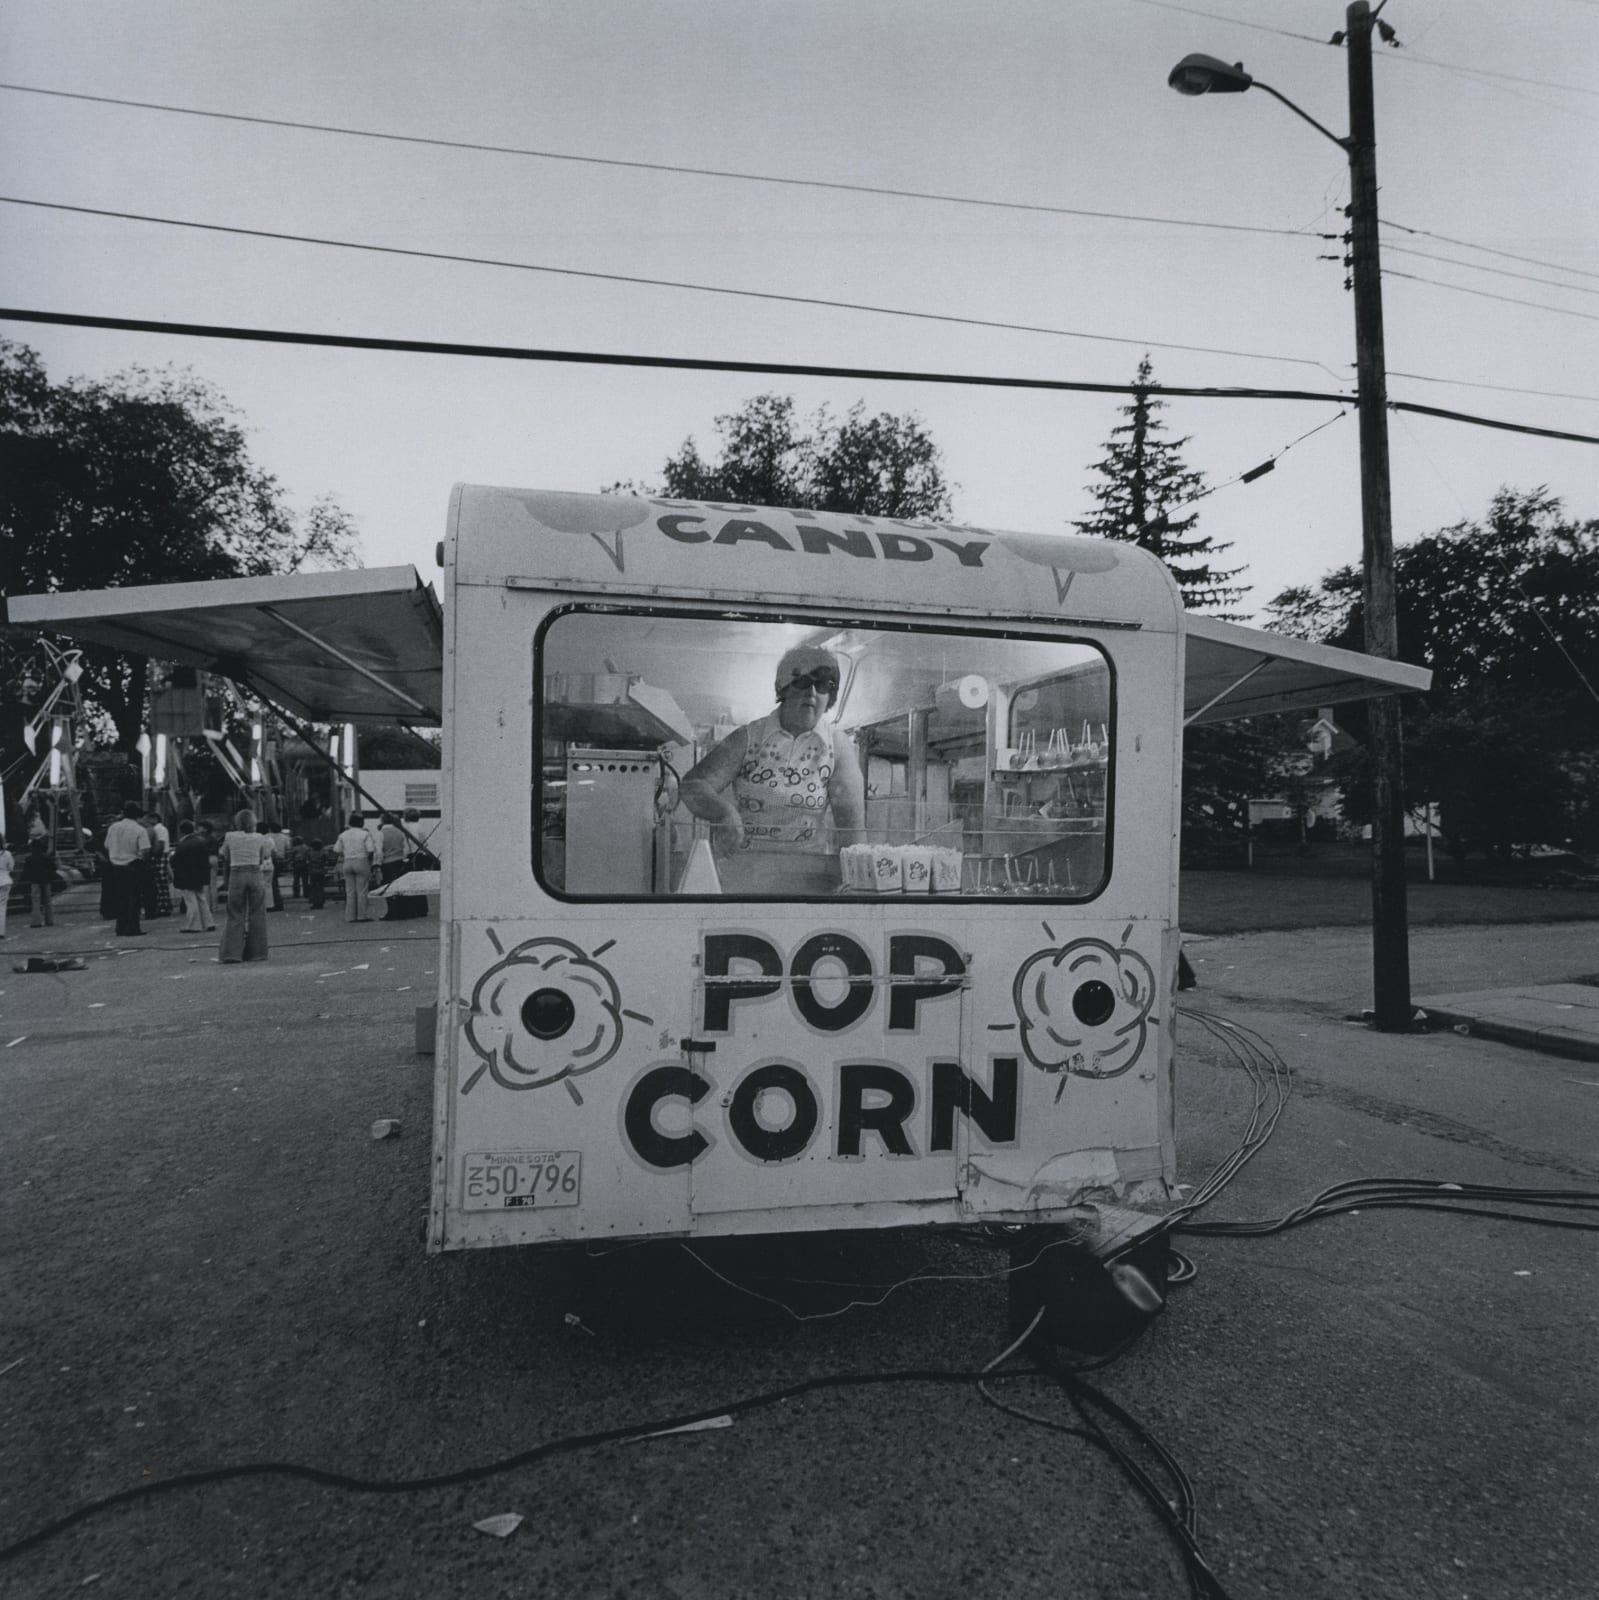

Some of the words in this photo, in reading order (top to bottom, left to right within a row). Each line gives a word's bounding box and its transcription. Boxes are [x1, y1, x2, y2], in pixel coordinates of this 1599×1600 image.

[656, 514, 991, 568] CANDY
[702, 929, 967, 1034] POP
[620, 1055, 1021, 1171] CORN
[490, 1154, 555, 1165] MINNESOTA
